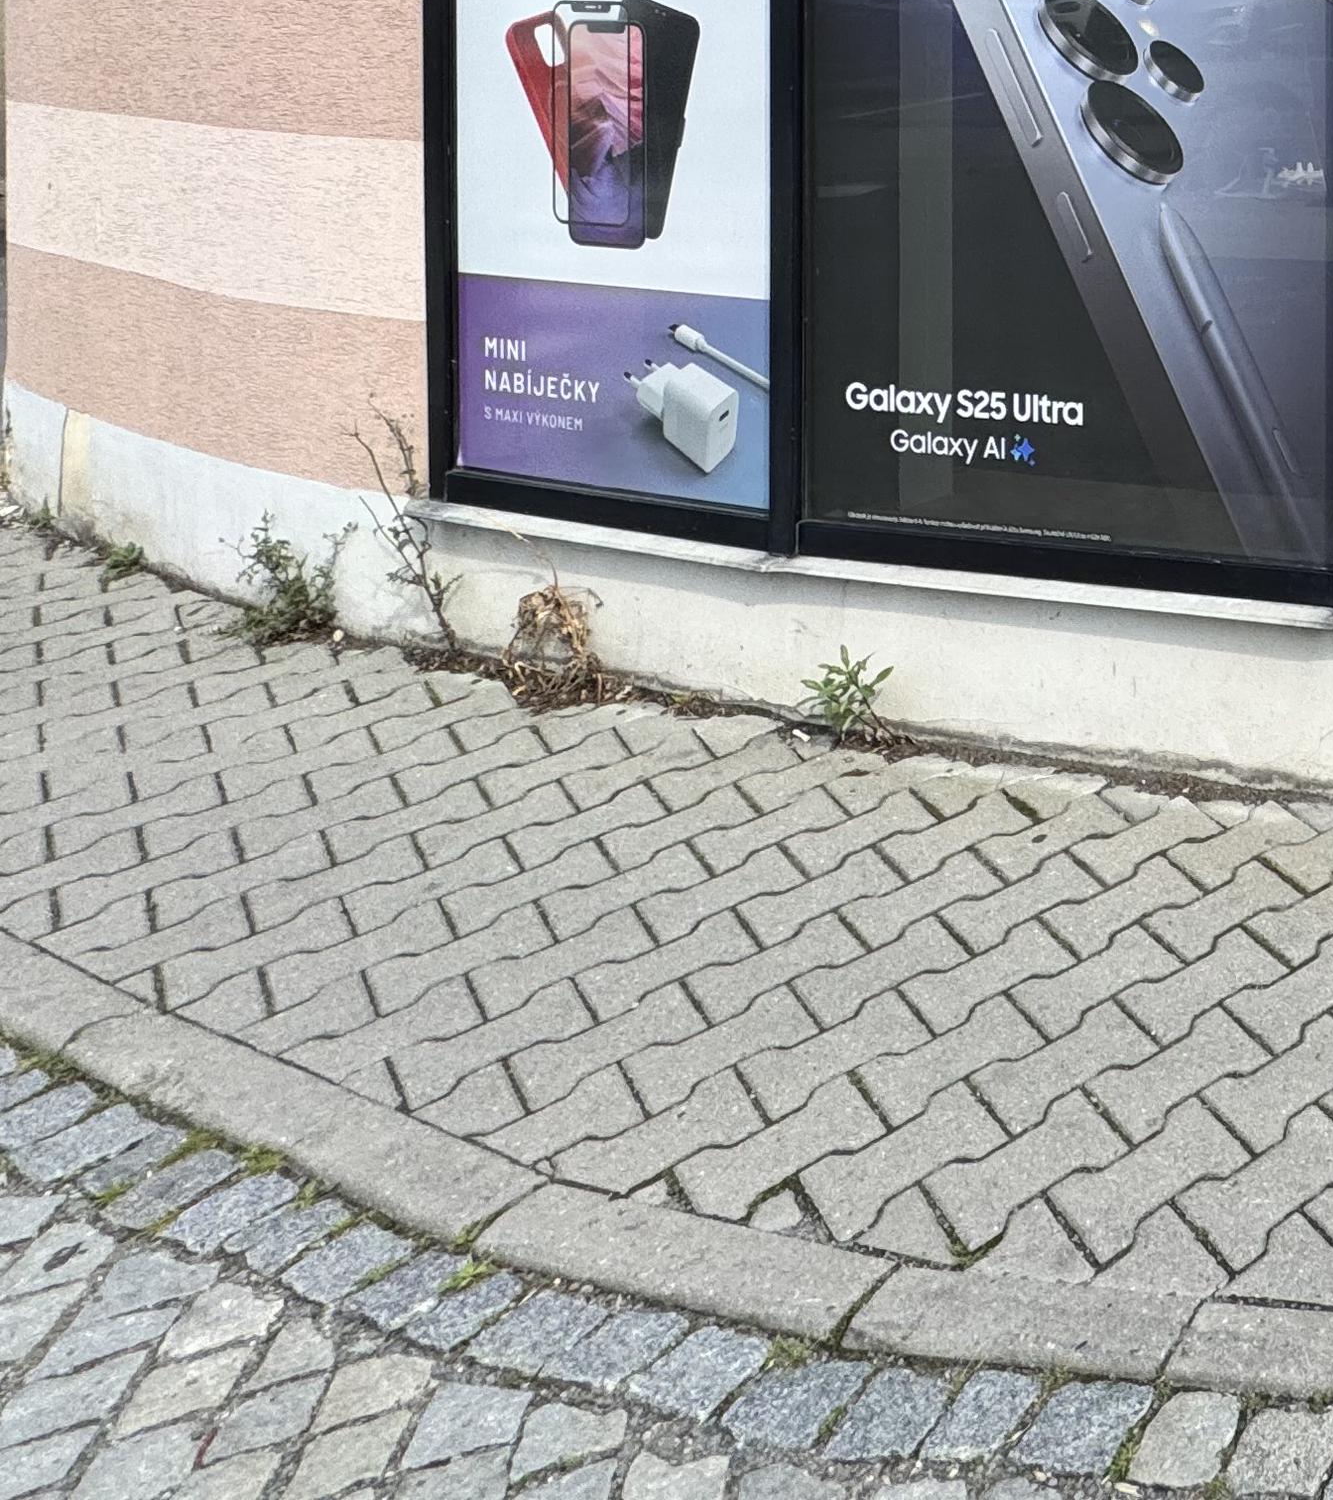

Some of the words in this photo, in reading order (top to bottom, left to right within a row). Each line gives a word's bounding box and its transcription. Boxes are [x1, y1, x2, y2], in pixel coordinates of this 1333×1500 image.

[484, 336, 526, 362] MINI
[484, 368, 600, 403] NABÍJEČKY
[483, 406, 493, 420] S
[495, 408, 523, 424] MAXI
[526, 410, 583, 431] VÝKONEM
[845, 381, 952, 423] Galaxy
[955, 389, 1007, 421] S25
[1012, 392, 1085, 427] Ultra
[889, 429, 978, 465] Galaxy
[982, 436, 1007, 460] AI
